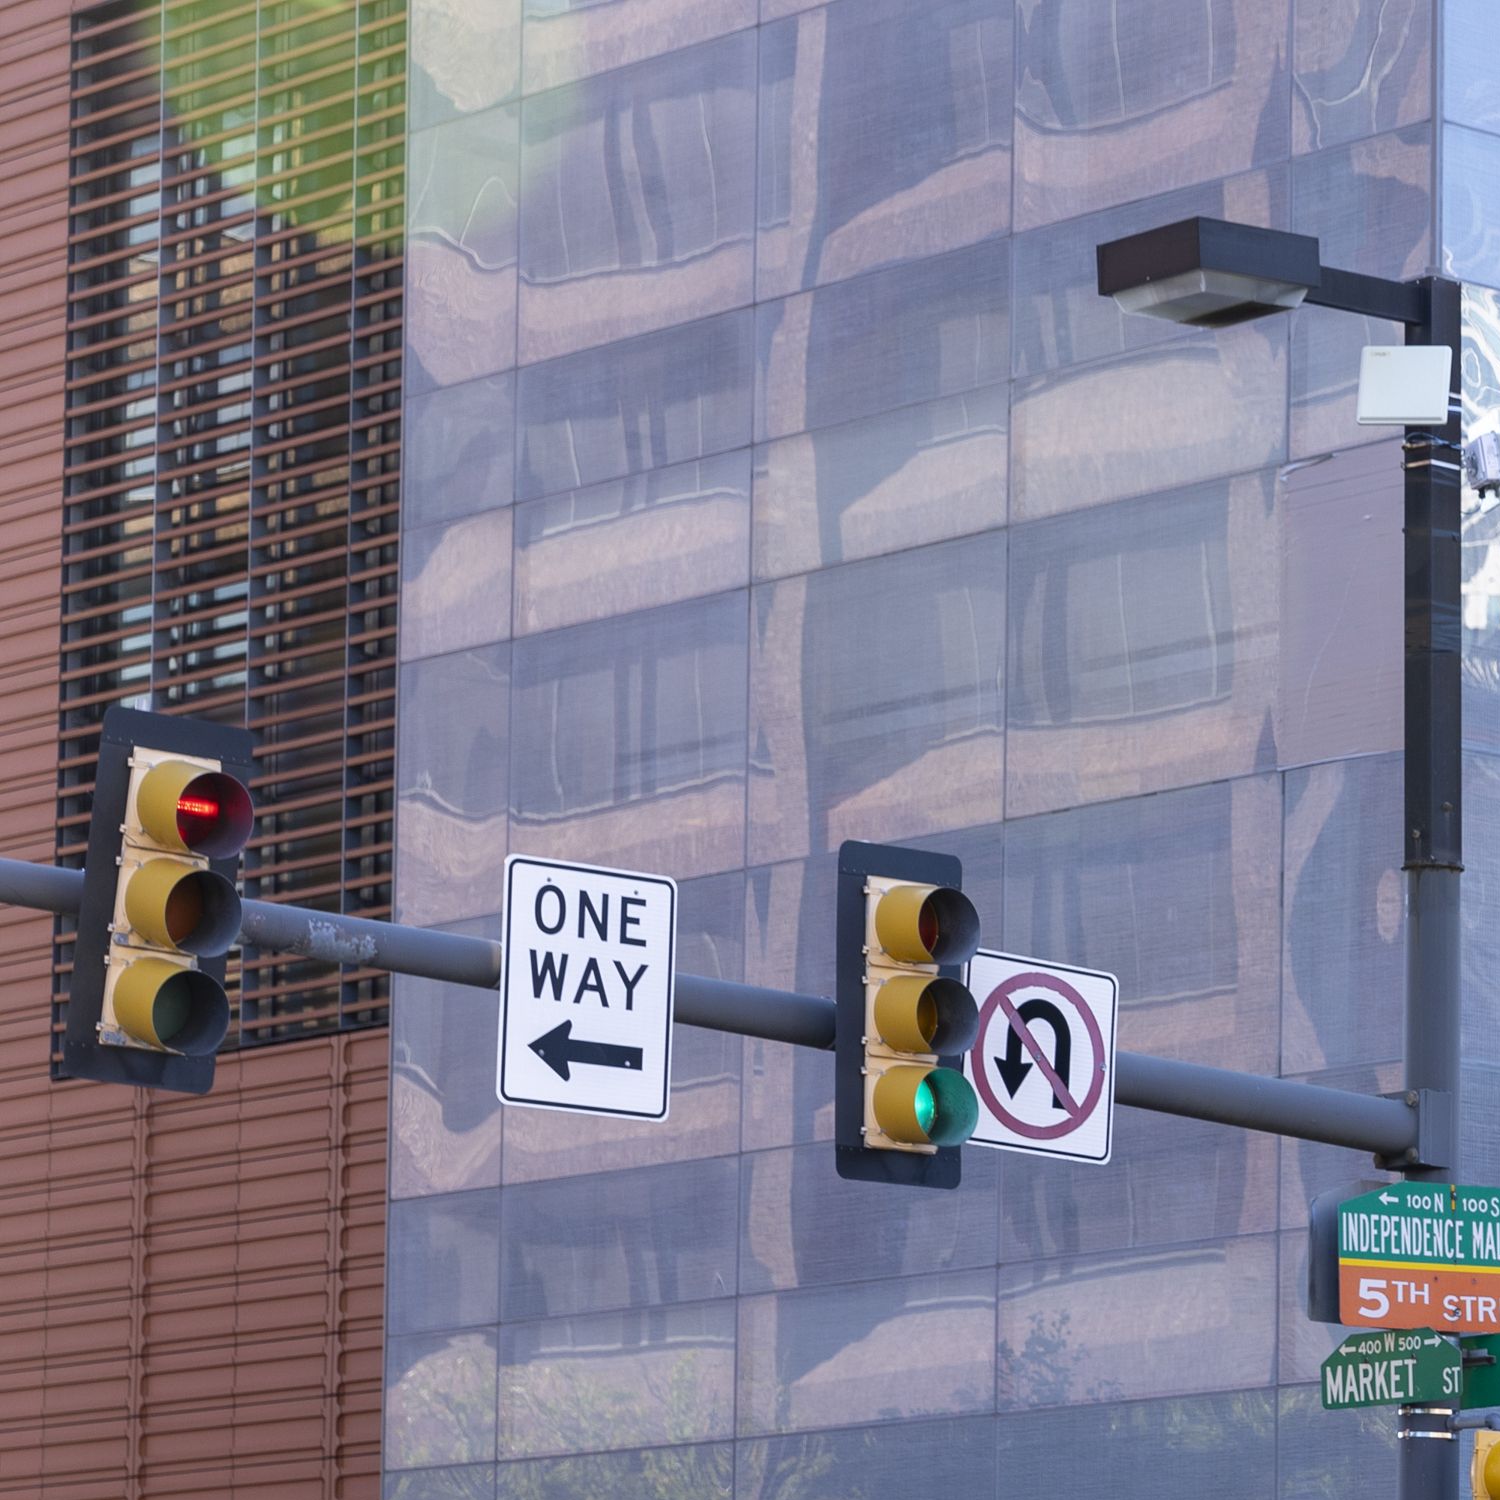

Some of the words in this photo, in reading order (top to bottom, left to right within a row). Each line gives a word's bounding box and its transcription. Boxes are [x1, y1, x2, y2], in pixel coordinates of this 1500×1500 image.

[534, 883, 648, 948] ONE
[529, 948, 650, 1012] WAY
[1406, 1194, 1432, 1210] 100
[1434, 1192, 1444, 1213] N
[1462, 1198, 1488, 1213] 100
[1490, 1196, 1500, 1218] S
[1342, 1212, 1465, 1259] INDEPENDENCE
[1357, 1277, 1430, 1319] 5TH
[1358, 1339, 1382, 1355] 400
[1383, 1332, 1396, 1353] W
[1398, 1335, 1422, 1351] 500
[1325, 1358, 1417, 1405] MARKET
[1442, 1366, 1461, 1394] ST
